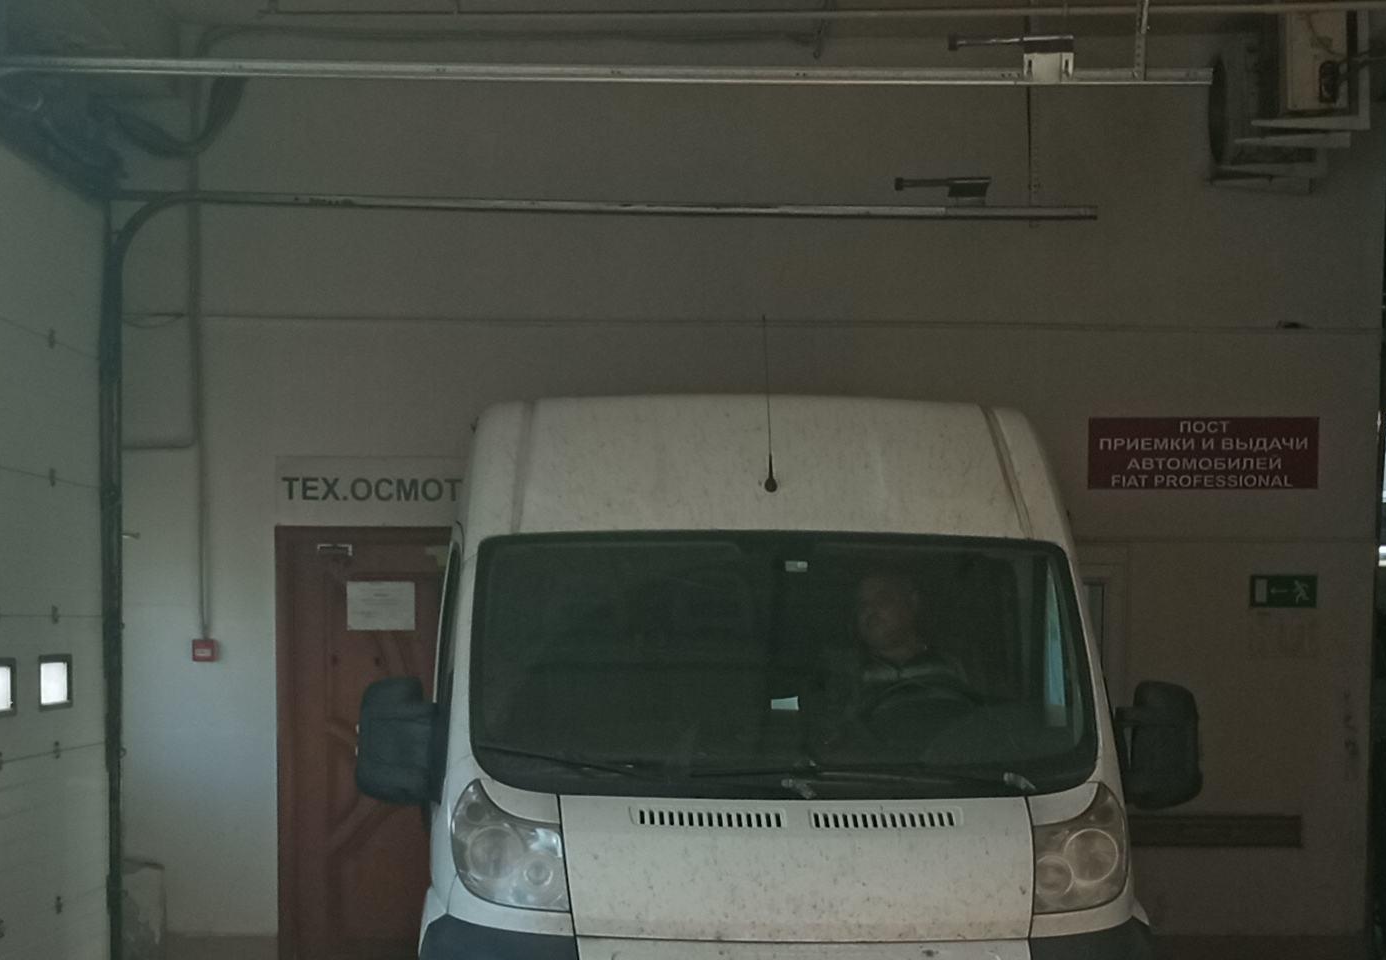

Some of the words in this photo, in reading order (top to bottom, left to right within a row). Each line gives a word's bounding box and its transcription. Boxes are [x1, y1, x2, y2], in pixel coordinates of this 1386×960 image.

[1179, 420, 1230, 434] ПОСТ
[1099, 437, 1195, 451] ПРИЕМКИ
[1201, 438, 1215, 451] И
[1221, 437, 1309, 453] ВЫДАЧИ
[1126, 454, 1283, 471] АВТОМОБИЛЕЙ
[281, 476, 463, 502] ТЕХ.ОСМОТ
[1111, 475, 1149, 488] FIAT
[1153, 474, 1294, 488] PROFESSIONAL
